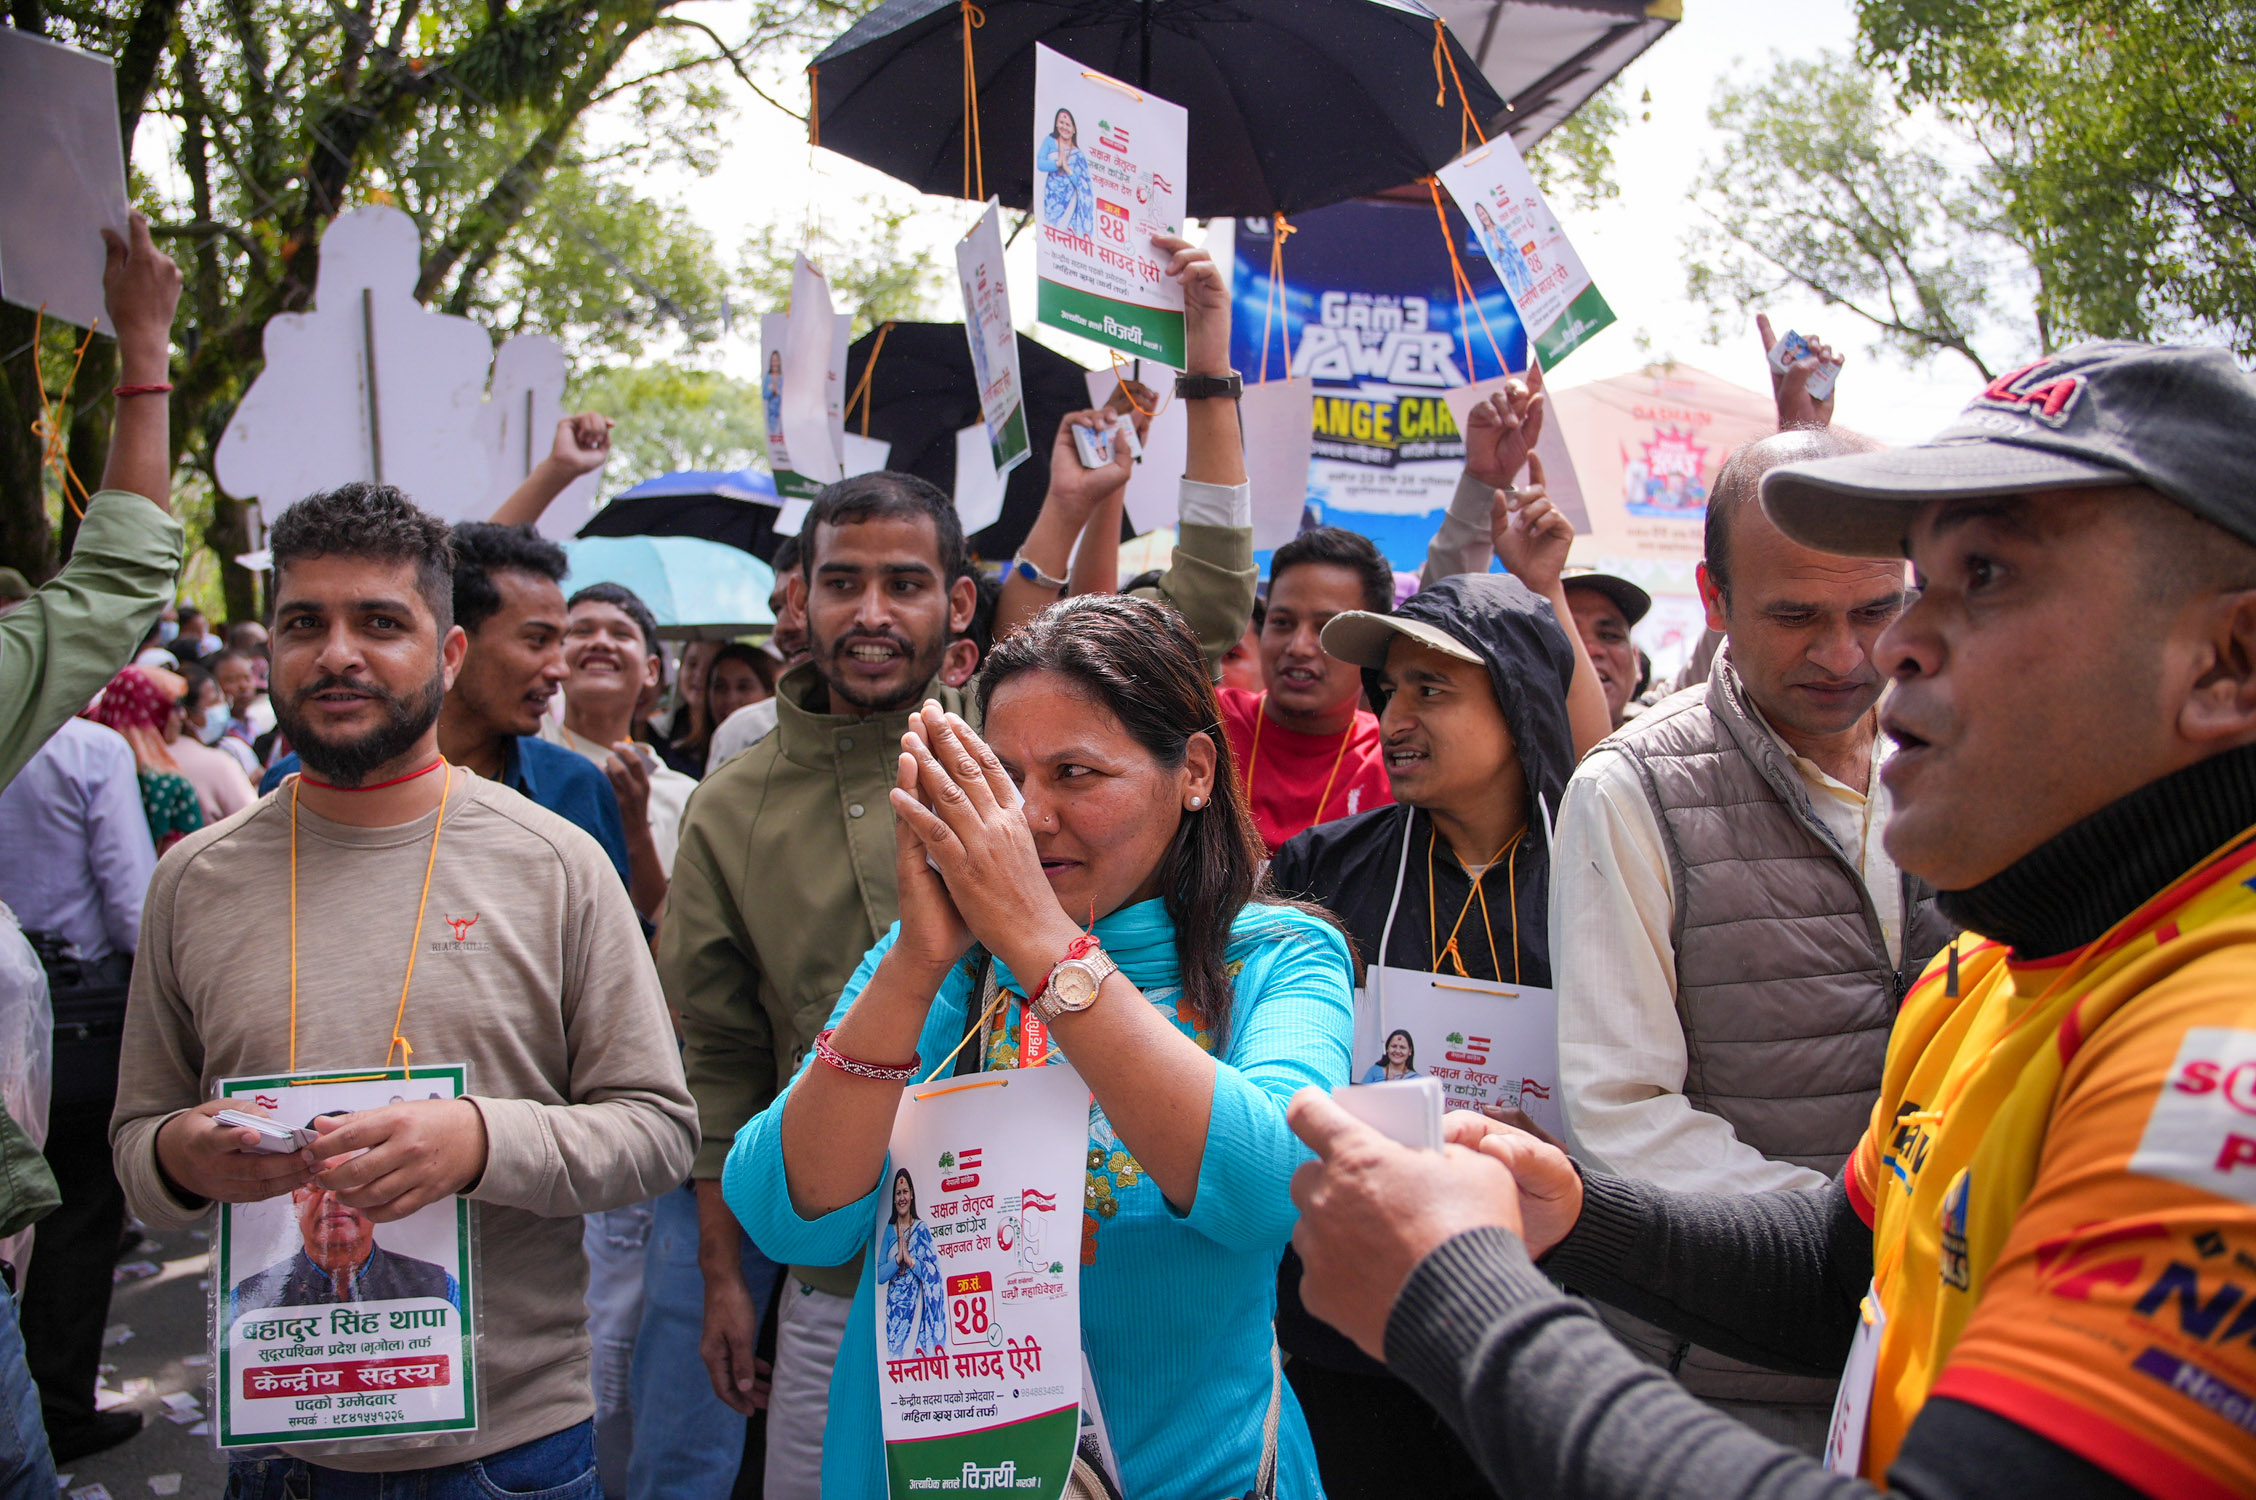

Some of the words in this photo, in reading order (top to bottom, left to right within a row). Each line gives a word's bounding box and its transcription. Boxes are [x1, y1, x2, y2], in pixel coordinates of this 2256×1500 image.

[1100, 214, 1126, 243] २४
[1043, 224, 1095, 258] सन्तोषी
[1097, 245, 1135, 278] साउद
[1138, 255, 1161, 284] ऐरी
[1103, 314, 1143, 345] विजयी
[1291, 323, 1469, 388] POWER
[1429, 1065, 1461, 1080] सक्षम
[1464, 1067, 1499, 1086] नेतृत्व
[1454, 1084, 1487, 1098] कांग्रेस
[930, 1201, 959, 1219] सक्षम
[961, 1194, 995, 1216] नेतृत्व
[930, 1223, 953, 1239] सबल
[956, 1216, 987, 1234] कांग्रेस
[937, 1239, 973, 1259] समुन्नत
[976, 1234, 992, 1251] देश
[1021, 1282, 1064, 1299] महाधिवेशन
[242, 1316, 322, 1343] बहादुर
[330, 1308, 381, 1335] सिंह
[389, 1308, 448, 1330] थापा
[953, 1296, 989, 1335] २४
[258, 1344, 324, 1362] सुदूरपश्चिम
[328, 1341, 356, 1358] प्रदेश
[360, 1338, 405, 1355] (भूगोल)
[409, 1335, 433, 1350] तर्फ
[886, 1344, 950, 1384] सन्तोषी
[952, 1349, 1005, 1381] साउद
[1007, 1335, 1042, 1380] ऐरी
[252, 1367, 344, 1393] केन्द्रीय
[356, 1363, 440, 1387] सदस्य
[295, 1395, 332, 1412] पदको
[337, 1392, 398, 1409] उम्मेदवार
[898, 1393, 922, 1408] केन्द्रीय
[922, 1394, 943, 1407] सदस्य
[943, 1390, 965, 1404] पदको
[965, 1390, 996, 1404] उम्मेदवार
[288, 1413, 318, 1428] सम्पर्क
[332, 1408, 405, 1425] ९८४१५५१२२६
[901, 1409, 932, 1423] (महिला
[953, 1406, 975, 1420] आर्य
[976, 1404, 999, 1418] तर्फ)
[962, 1460, 1017, 1491] विजयी
